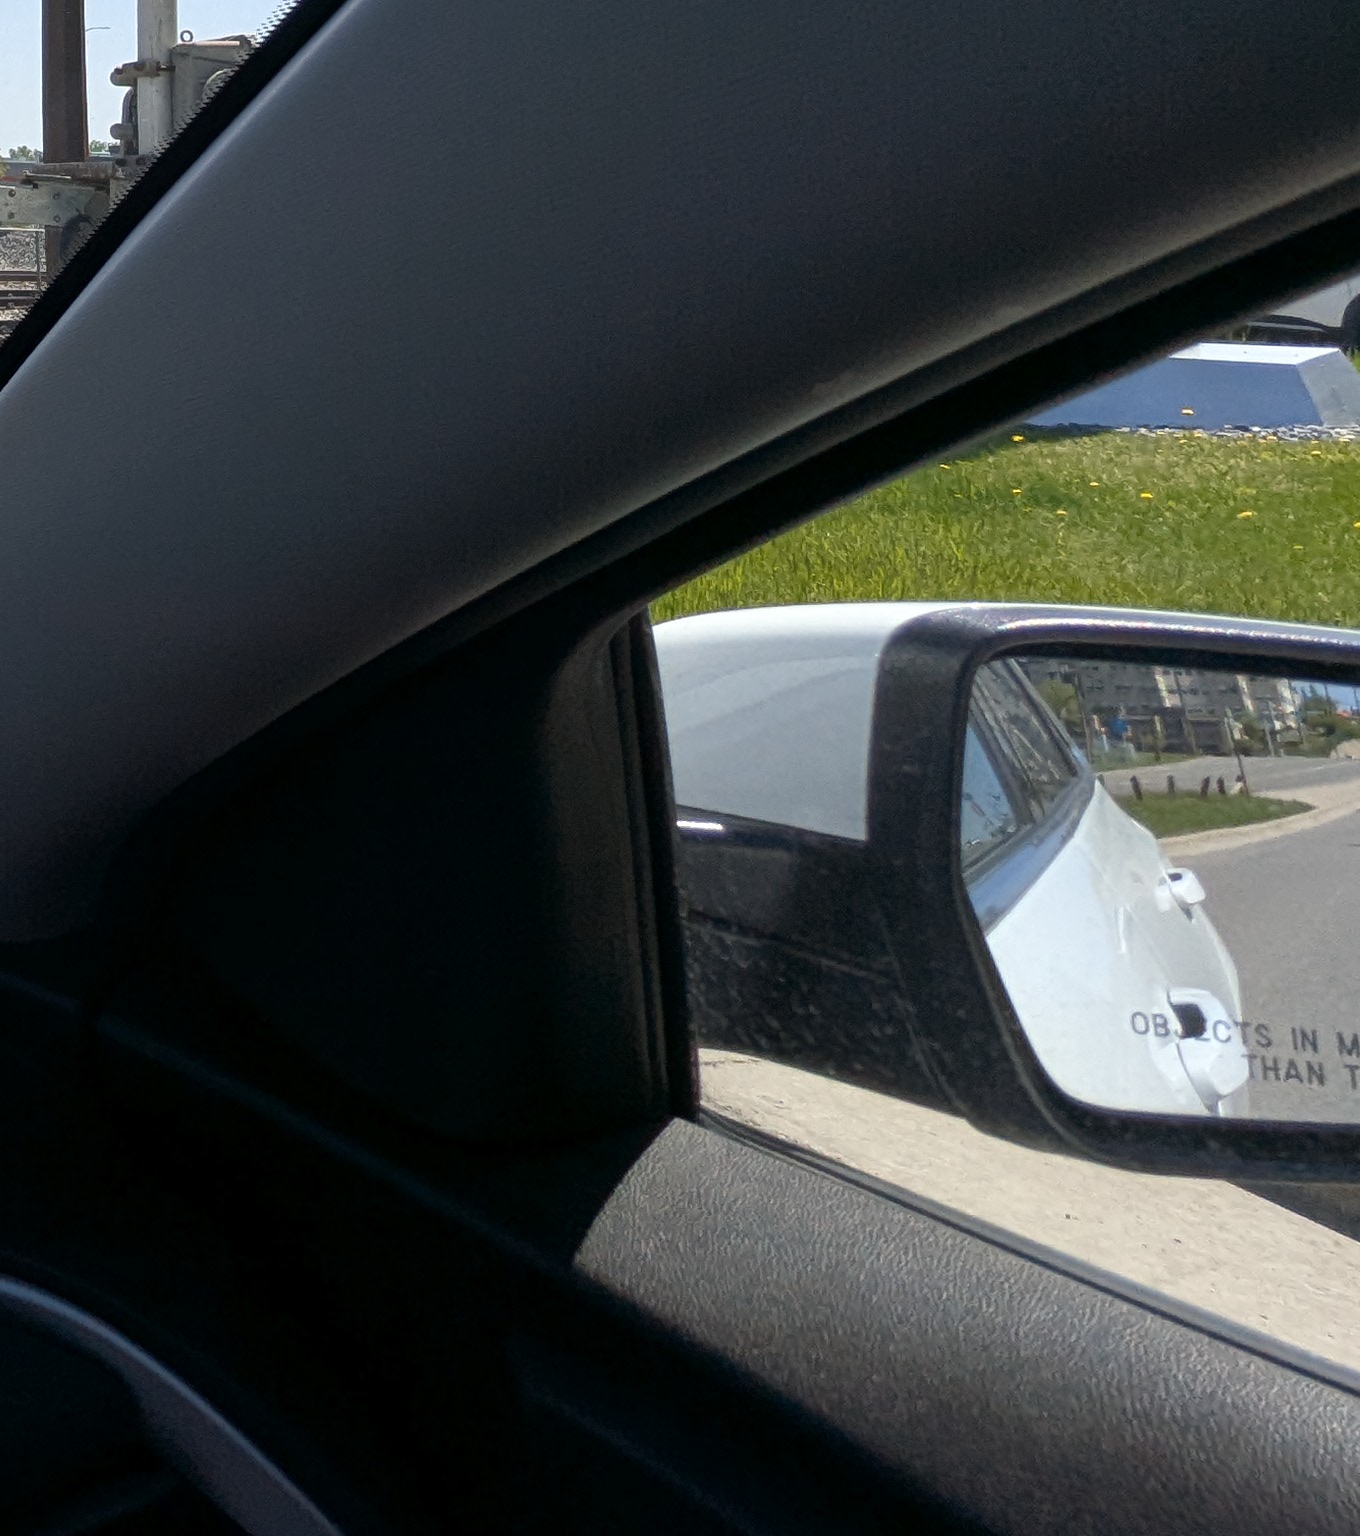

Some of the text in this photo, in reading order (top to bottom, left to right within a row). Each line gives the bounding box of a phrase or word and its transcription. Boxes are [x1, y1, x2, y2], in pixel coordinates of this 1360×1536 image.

[1131, 1011, 1273, 1049] OBCTS
[1290, 1026, 1319, 1054] IN
[1241, 1052, 1326, 1087] THAN
